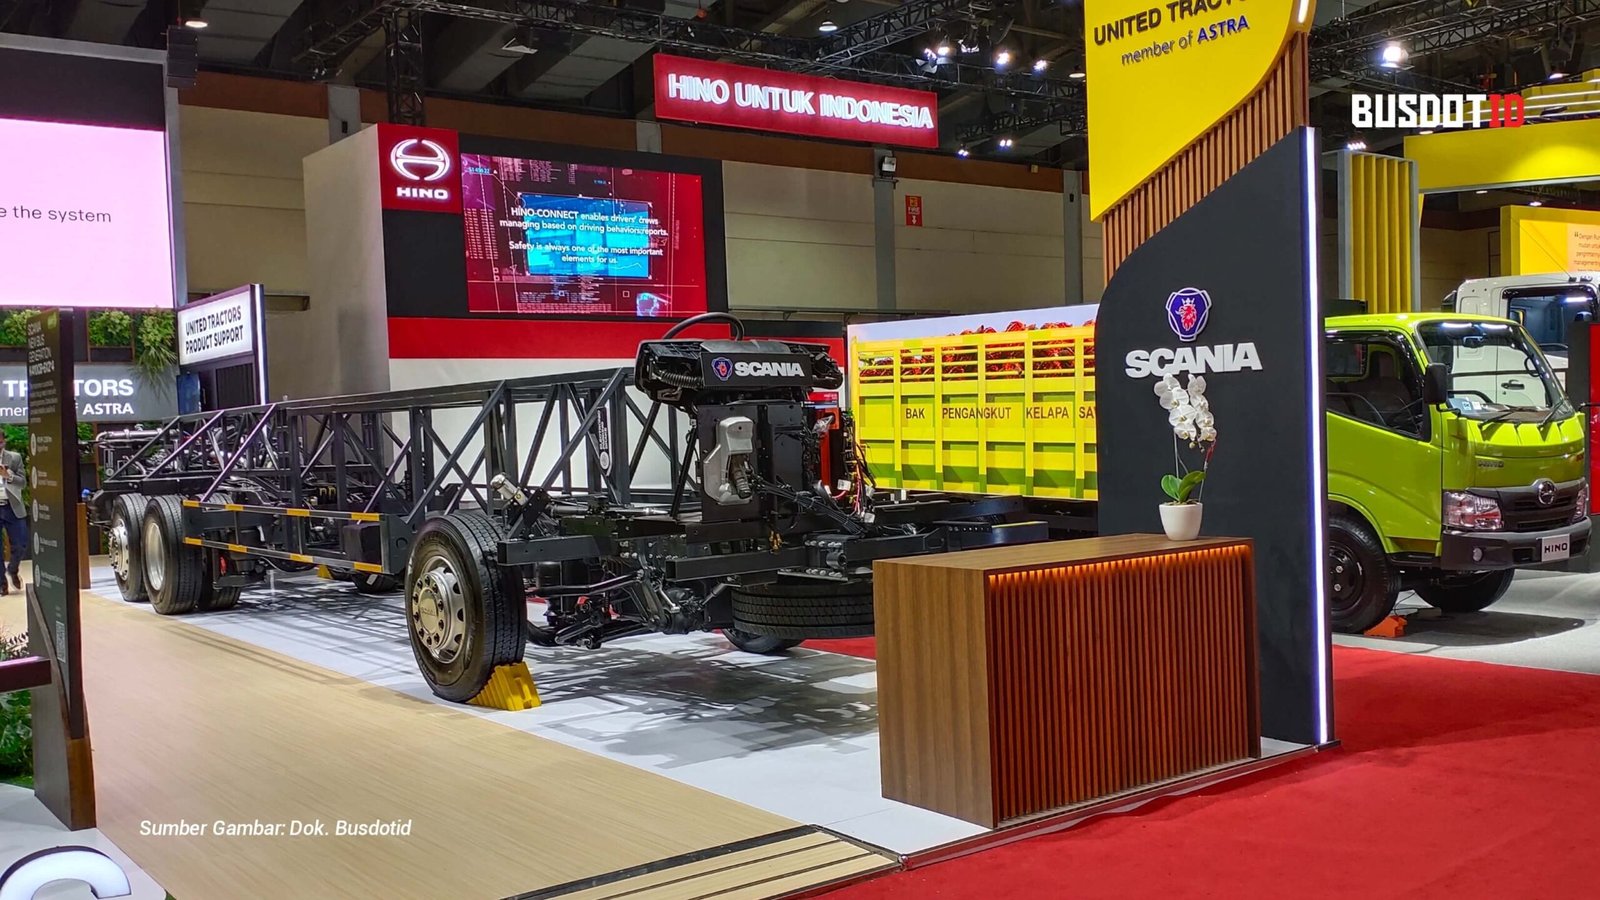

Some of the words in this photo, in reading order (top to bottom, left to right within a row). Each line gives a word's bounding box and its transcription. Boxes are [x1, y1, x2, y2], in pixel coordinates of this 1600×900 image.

[1094, 7, 1161, 46] UNITED
[1121, 39, 1175, 66] member
[1178, 29, 1194, 49] of
[1197, 15, 1250, 43] ASTRA
[667, 73, 730, 104] HINO
[734, 82, 815, 115] UNTUK
[819, 93, 934, 129] INDONESIA
[396, 186, 449, 200] HINO
[12, 205, 42, 219] the
[48, 209, 112, 223] system
[510, 206, 579, 219] HINO-CONNECT
[580, 211, 609, 222] enables
[638, 216, 659, 225] crews
[499, 219, 540, 231] managing
[541, 220, 566, 230] based
[579, 223, 605, 234] driving
[508, 240, 535, 252] Safety
[536, 242, 543, 250] is
[544, 243, 571, 254] always
[587, 244, 597, 253] of
[598, 245, 609, 253] the
[610, 247, 628, 255] most
[629, 247, 664, 257] important
[561, 254, 594, 263] elements
[596, 254, 608, 263] for
[186, 316, 208, 336] UNITED
[207, 305, 242, 330] TRACTORS
[186, 334, 213, 354] PRODUCT
[213, 325, 243, 347] SUPPORT
[734, 361, 805, 377] SCANIA
[1125, 342, 1263, 379] SCANIA
[82, 402, 135, 416] ASTRA
[905, 407, 925, 419] BAK
[942, 406, 1012, 420] PENGANGKUT
[1025, 406, 1070, 419] KELAPA
[1544, 542, 1568, 554] HINO
